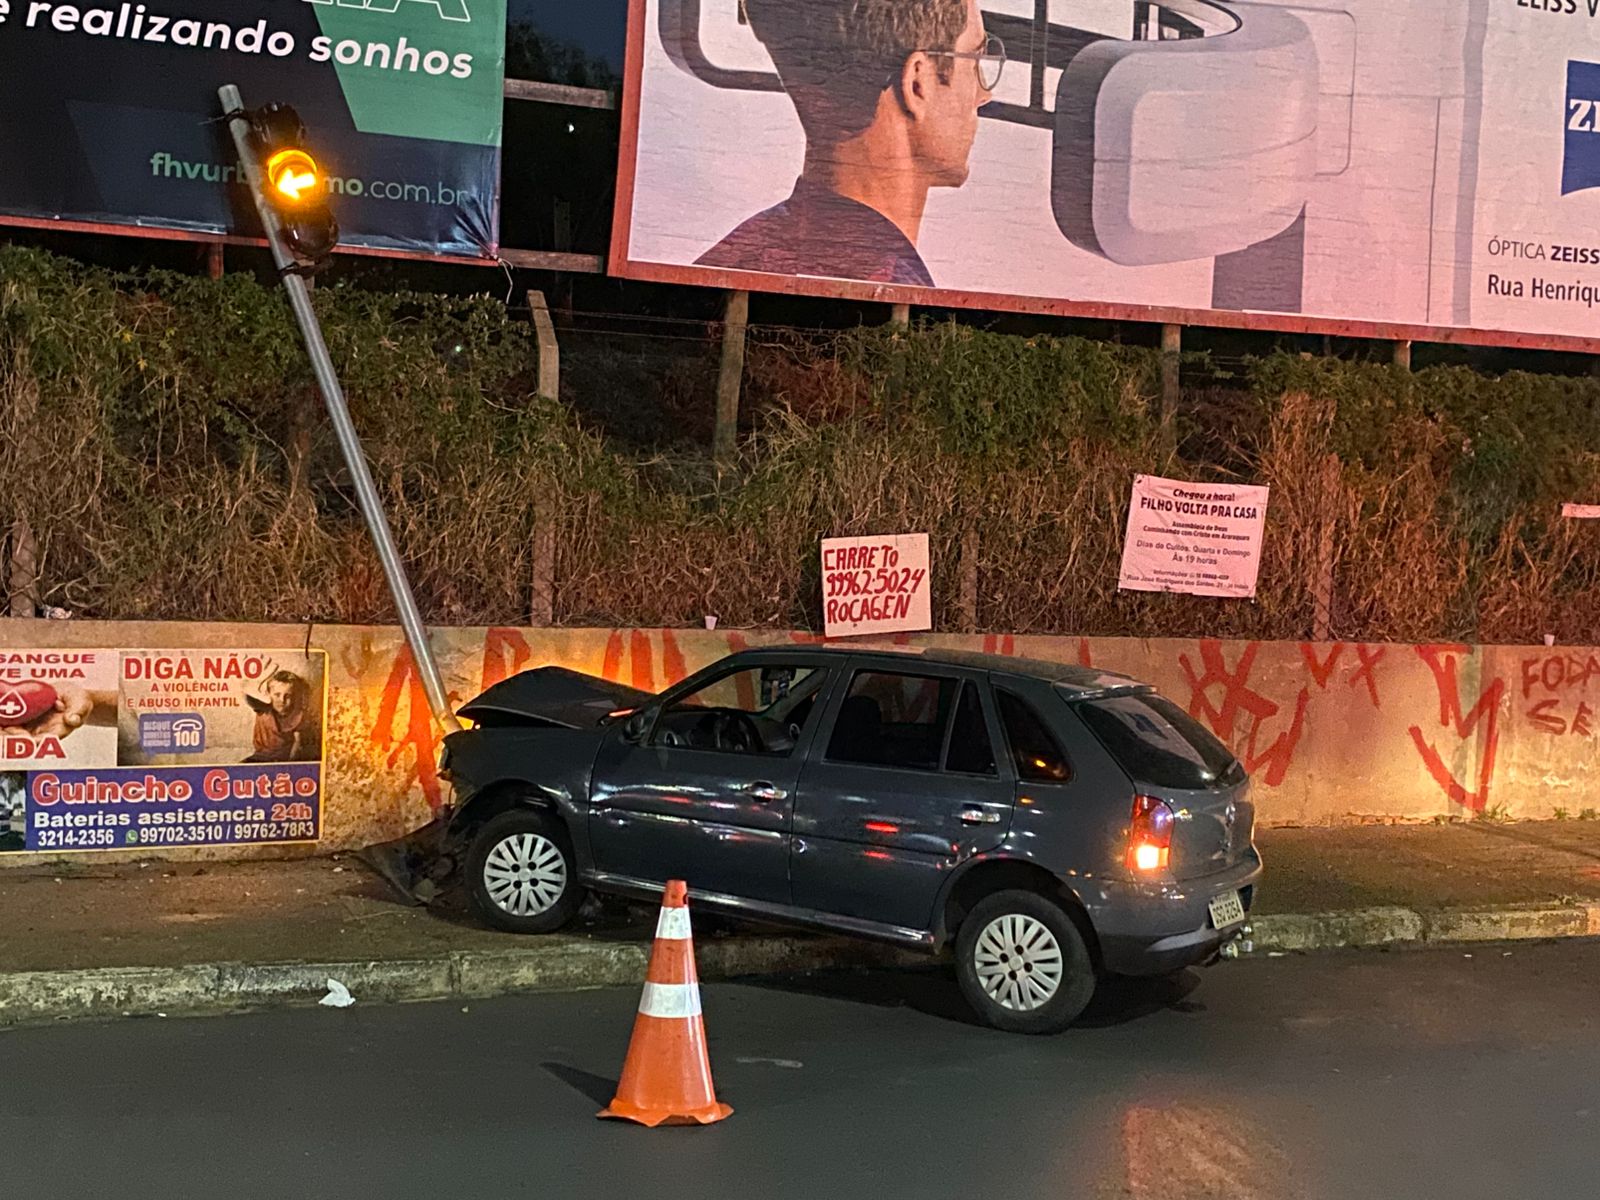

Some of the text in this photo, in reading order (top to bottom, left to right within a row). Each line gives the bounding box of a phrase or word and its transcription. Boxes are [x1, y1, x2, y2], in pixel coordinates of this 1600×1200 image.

[25, 2, 295, 57] realizando
[308, 37, 473, 79] sonhos
[1487, 235, 1600, 264] ÓPTICA ZEISS
[1487, 274, 1524, 297] Rua
[1173, 488, 1205, 500] Chegou
[1140, 497, 1257, 519] FILHO VOLTA PRA CASA
[1206, 523, 1213, 531] de
[1136, 540, 1153, 549] Dias
[1193, 545, 1215, 554] Quarta
[1222, 548, 1251, 558] Domingo
[1185, 555, 1195, 563] 19
[1196, 556, 1217, 565] horas
[30, 668, 86, 678] UMA
[124, 653, 263, 680] DIGA NÃO
[151, 683, 159, 692] A
[127, 697, 240, 708] E ABUSO INFANTIL
[174, 730, 200, 747] 100
[32, 769, 317, 806] Guincho Gutão
[34, 803, 312, 828] Baterias assistencia 24h
[38, 829, 114, 846] 3214-2356
[140, 825, 222, 843] 99702-3510
